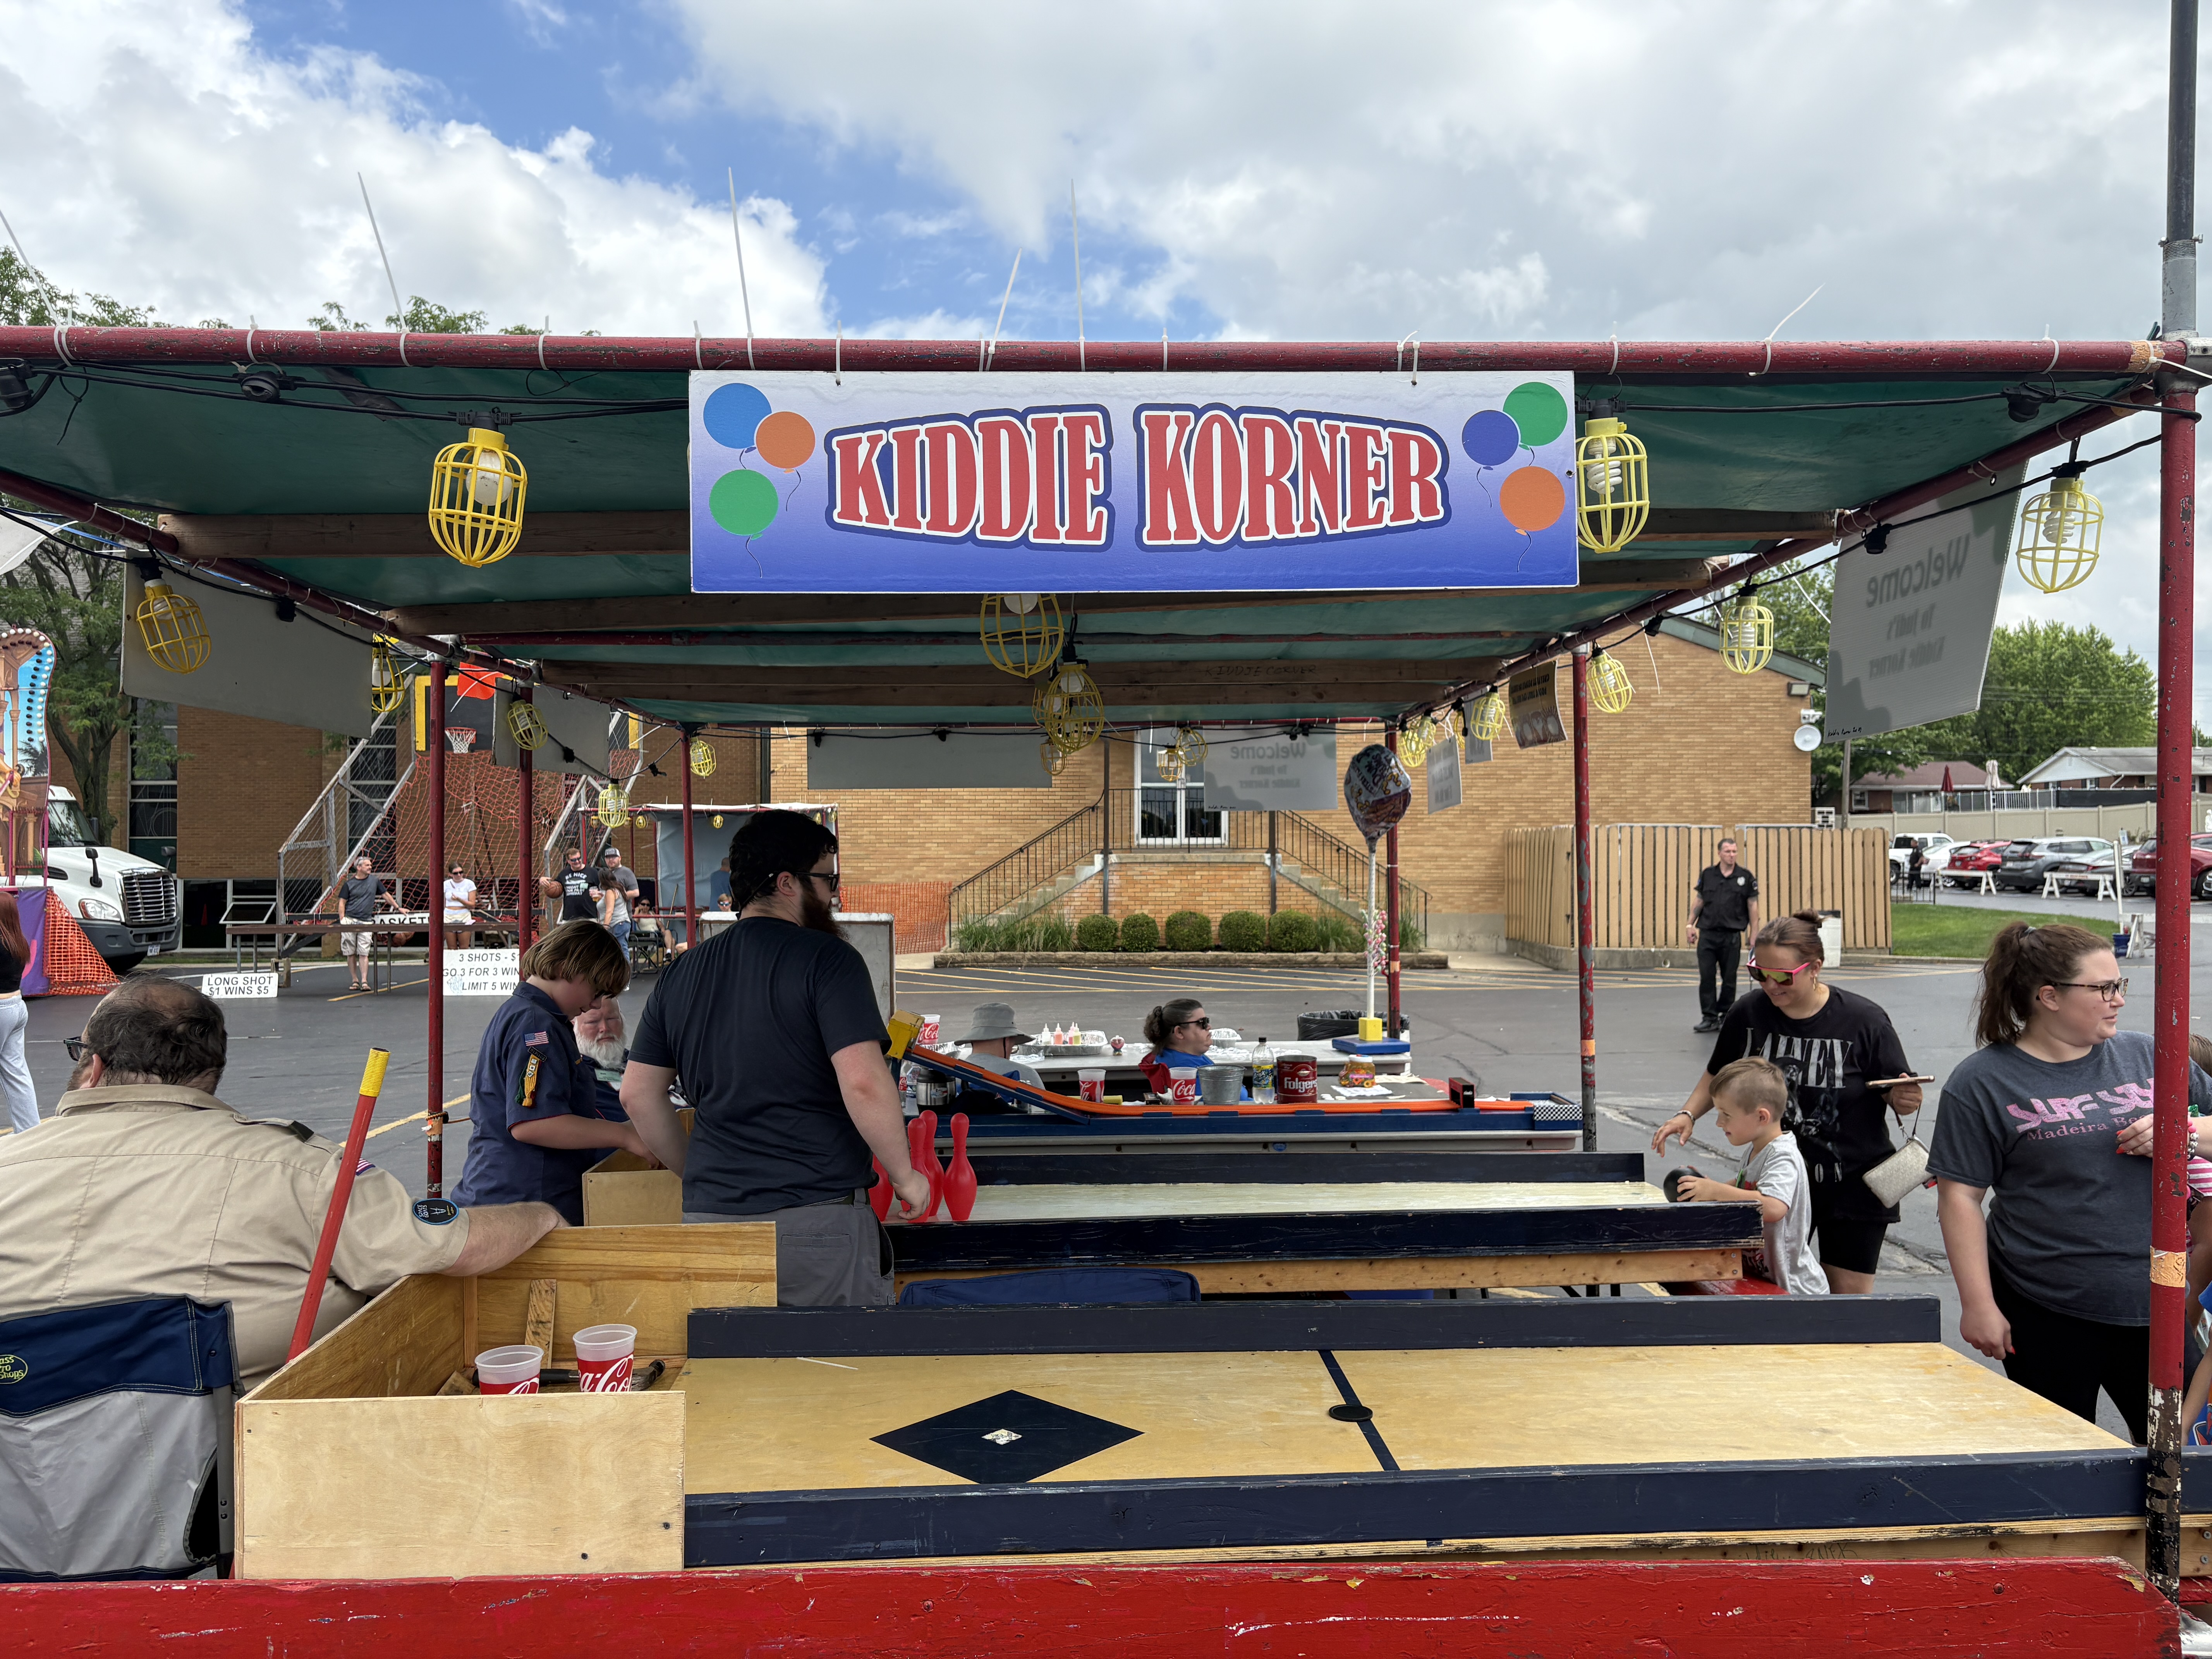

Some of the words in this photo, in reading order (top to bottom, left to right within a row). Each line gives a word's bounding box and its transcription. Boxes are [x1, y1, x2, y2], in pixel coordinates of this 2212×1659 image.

[831, 409, 1108, 548] KIDDIE
[1141, 408, 1446, 543] KORNER
[468, 953, 501, 962] SHOTS
[443, 968, 457, 976] GO
[460, 968, 465, 976] 3
[469, 968, 489, 976] FOR
[493, 967, 498, 975] 3
[208, 977, 238, 986] LONG
[243, 976, 273, 985] SHOT
[209, 986, 220, 995] $1
[225, 986, 252, 994] WINS
[257, 986, 268, 995] $5
[500, 982, 518, 990] WIN
[1284, 1077, 1317, 1093] Folgers
[2027, 1123, 2109, 1141] Madeira
[2111, 1115, 2146, 1128] Be
[0, 1356, 14, 1364] ass
